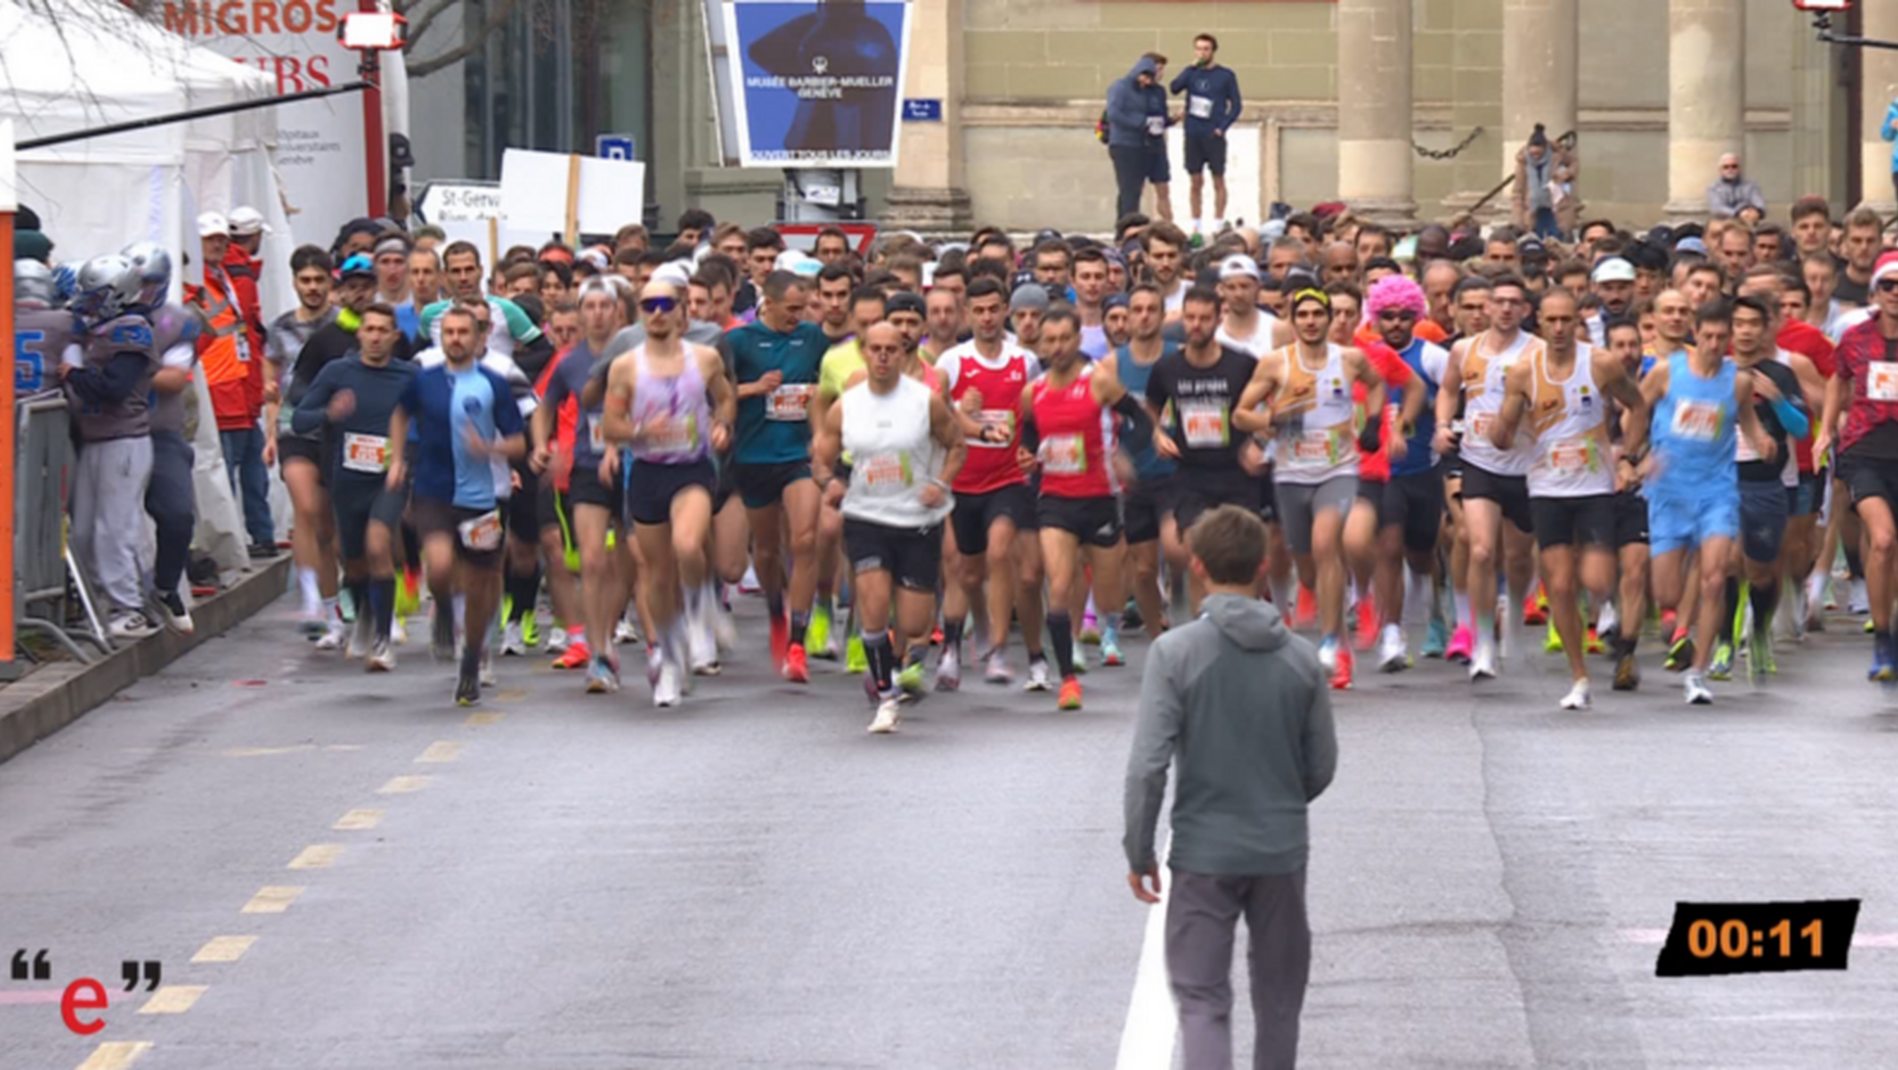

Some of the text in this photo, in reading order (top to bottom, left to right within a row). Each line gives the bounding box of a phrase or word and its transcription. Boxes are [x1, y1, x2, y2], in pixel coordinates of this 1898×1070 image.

[163, 0, 338, 36] MIGROS
[747, 75, 893, 88] MUSÉE BARBIER-MUELLER
[797, 87, 843, 99] GENÈVE
[277, 129, 320, 142] ôpitaux
